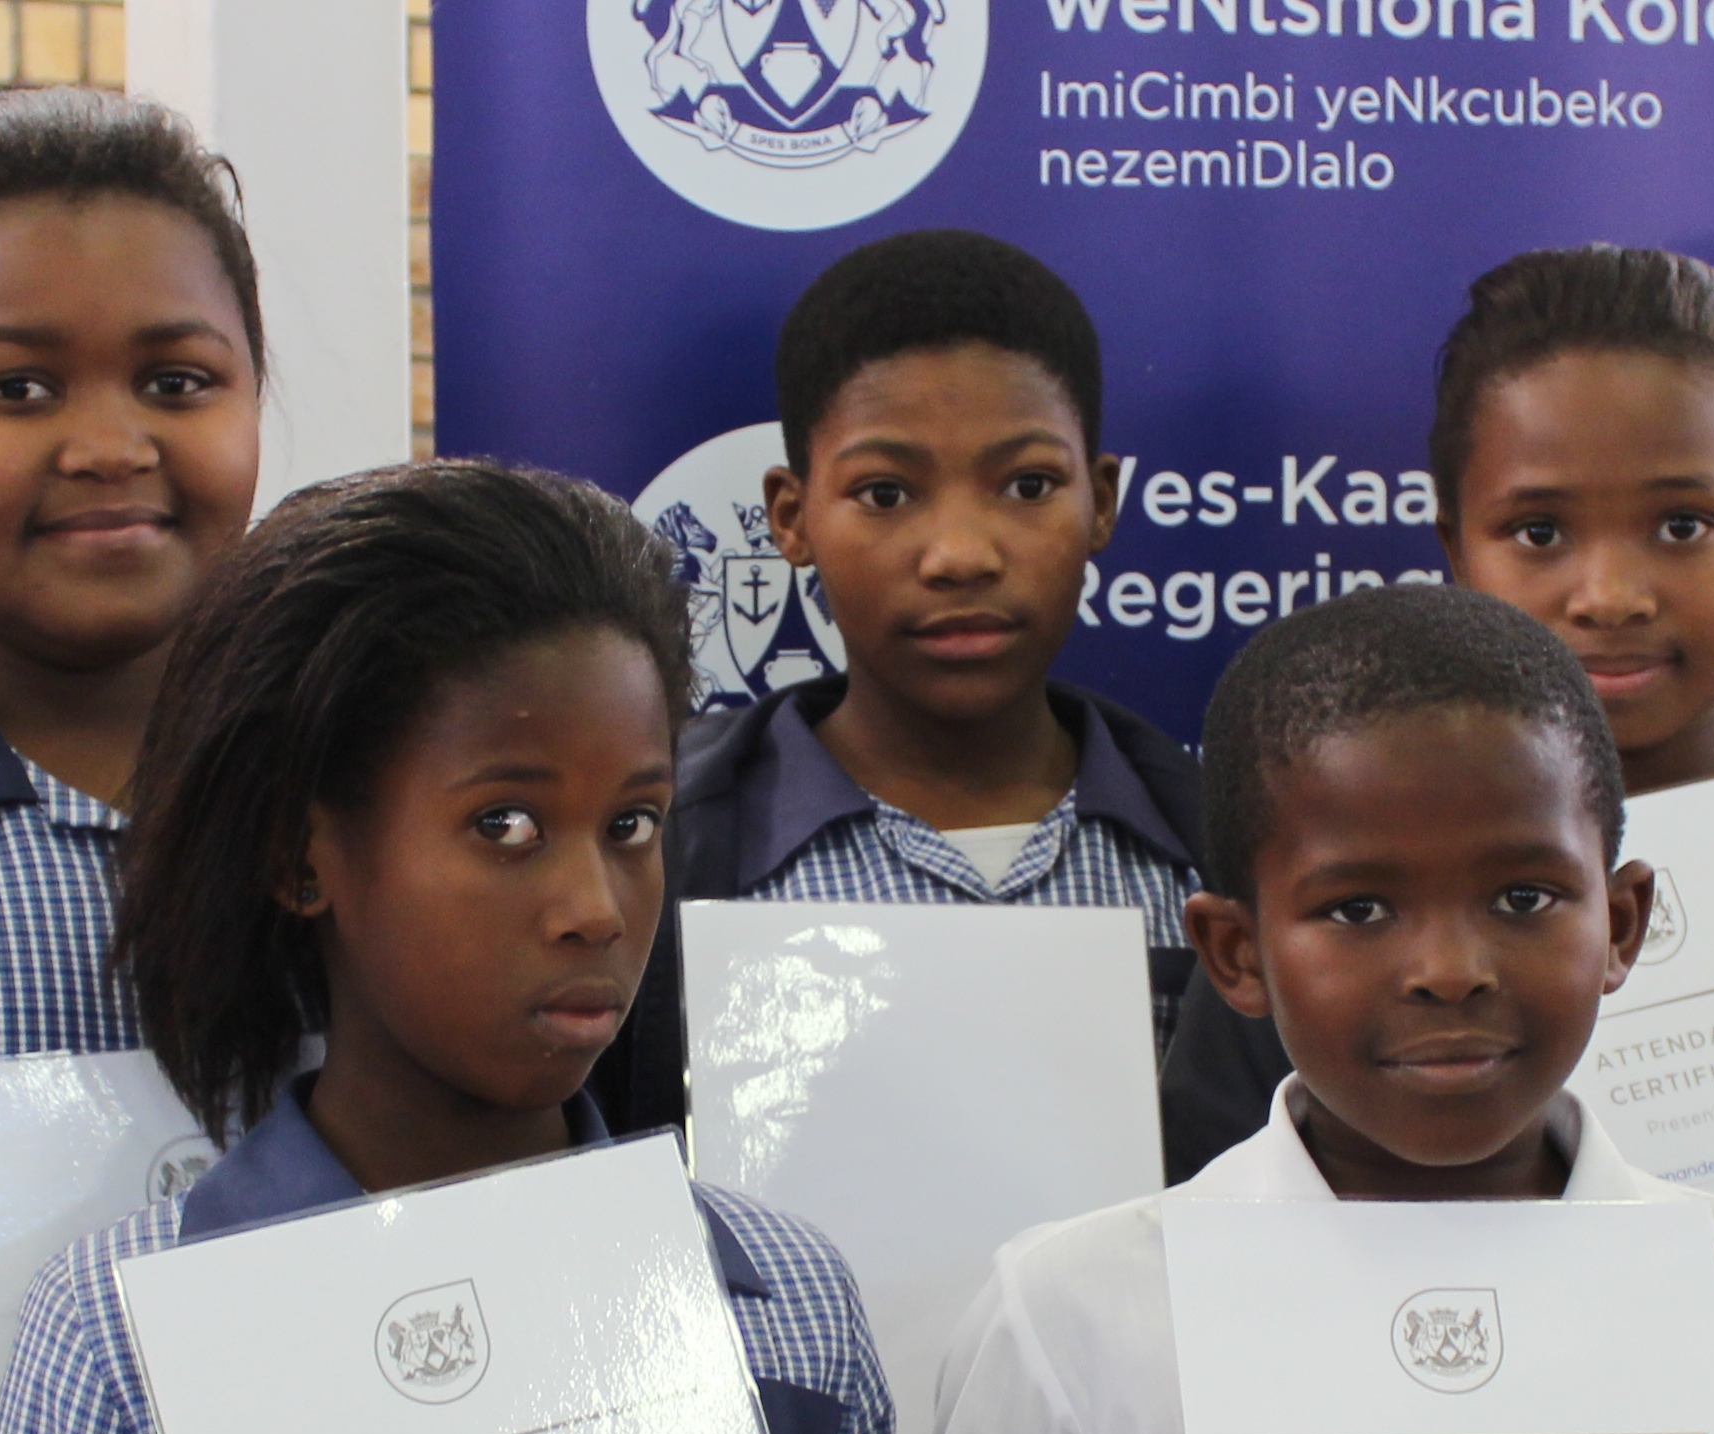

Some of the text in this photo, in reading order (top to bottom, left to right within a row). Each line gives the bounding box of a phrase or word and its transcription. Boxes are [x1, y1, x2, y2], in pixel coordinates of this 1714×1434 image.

[1039, 70, 1664, 131] ImiCimbi yeNkcubeko
[750, 133, 833, 150] SPES BONA
[1039, 139, 1395, 191] nezemiDlalo
[1115, 454, 1438, 528] es-Kaa
